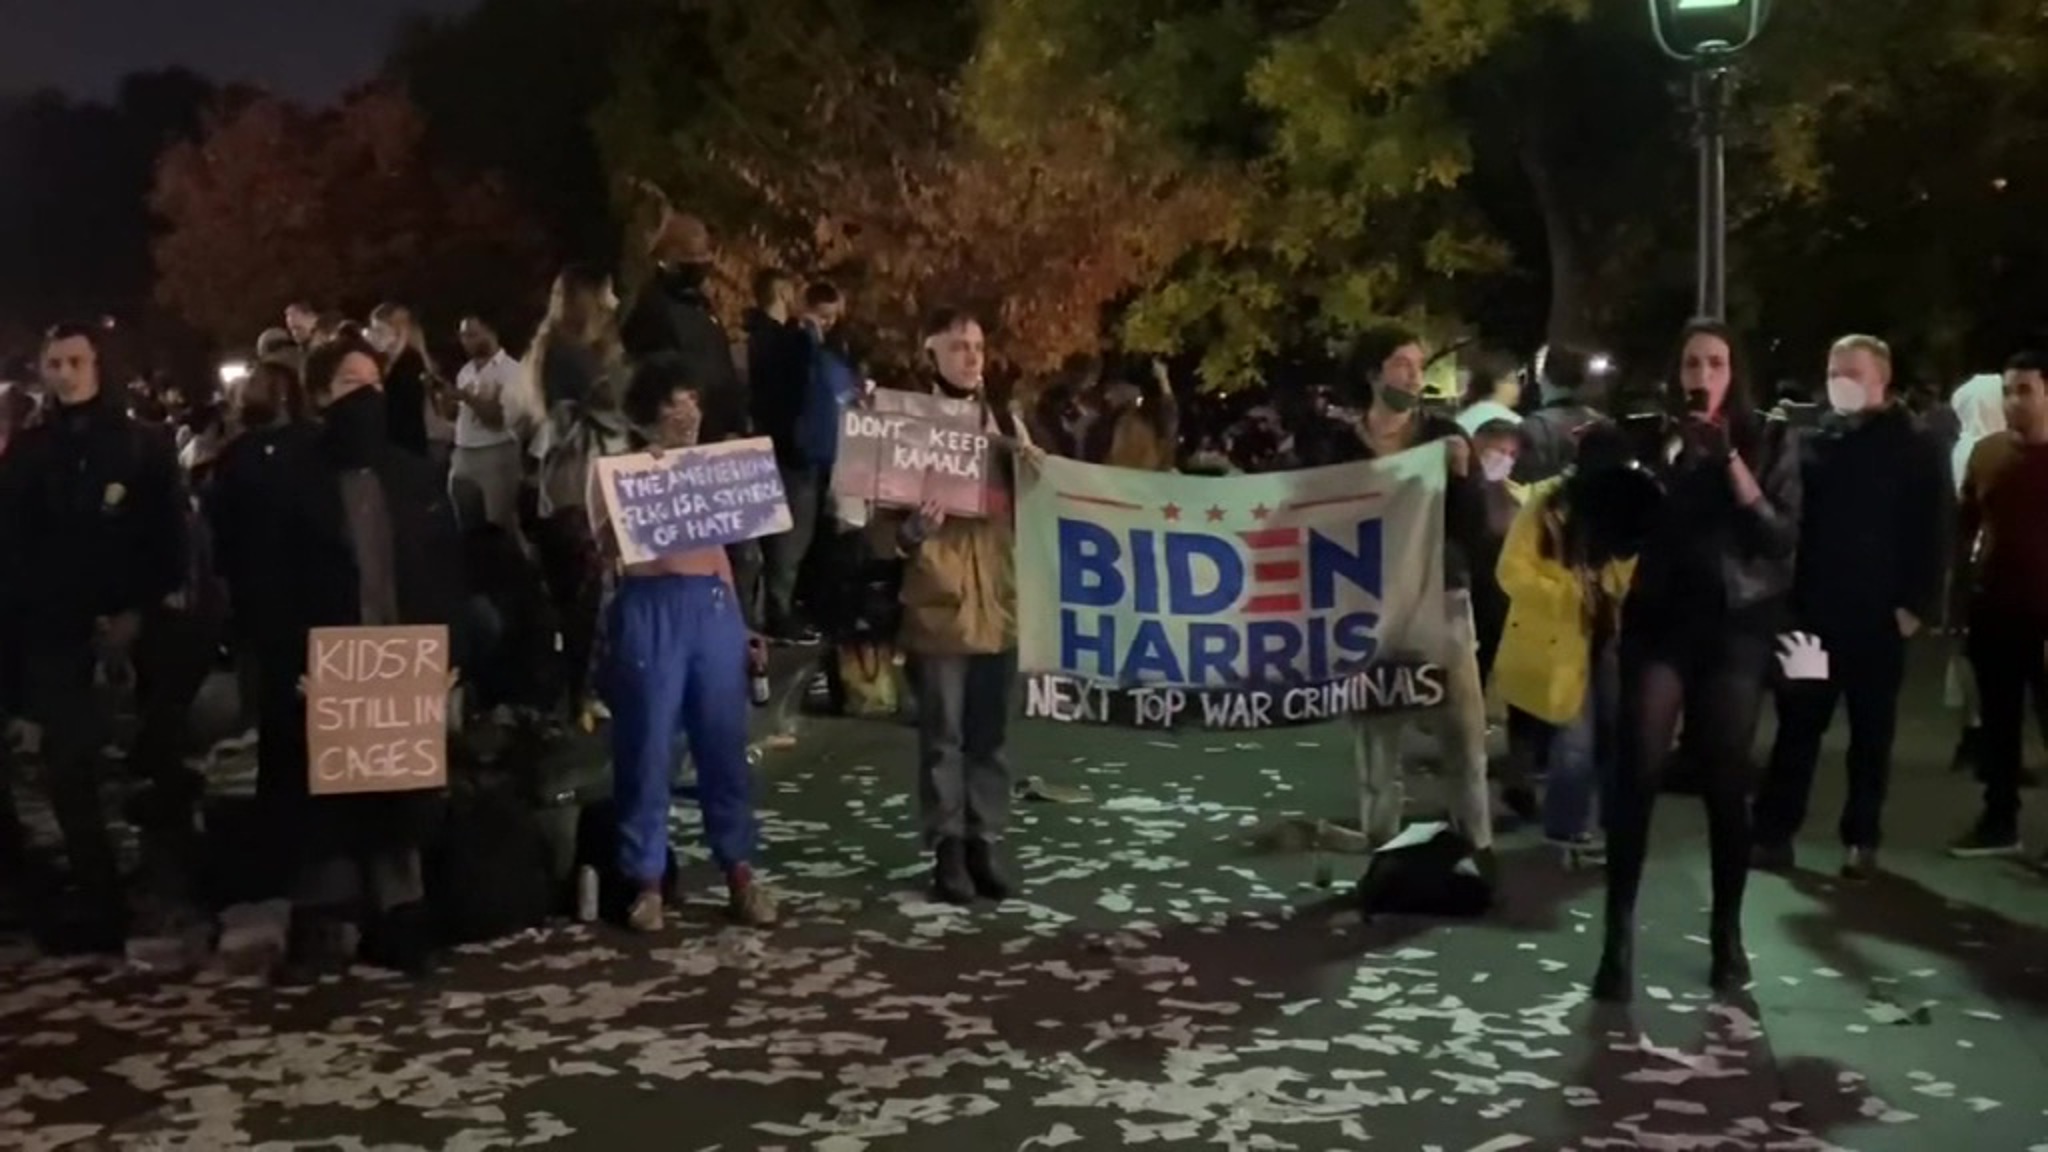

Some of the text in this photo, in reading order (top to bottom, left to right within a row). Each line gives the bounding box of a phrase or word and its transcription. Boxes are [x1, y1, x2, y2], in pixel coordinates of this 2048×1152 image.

[929, 427, 989, 459] KEEP
[893, 445, 980, 479] KAMALA
[618, 475, 664, 498] THE
[672, 493, 691, 516] IS
[693, 493, 711, 514] A
[653, 510, 744, 545] OF HATE
[1057, 517, 1383, 616] BIDEN
[317, 638, 442, 683] KIDS R
[1060, 608, 1382, 686] HARRIS
[317, 696, 442, 730] STILL IN
[1025, 674, 1111, 723] NEXT
[1199, 691, 1273, 729] WAR
[1282, 663, 1446, 720] CRIMINALS
[318, 739, 438, 780] CAGES
